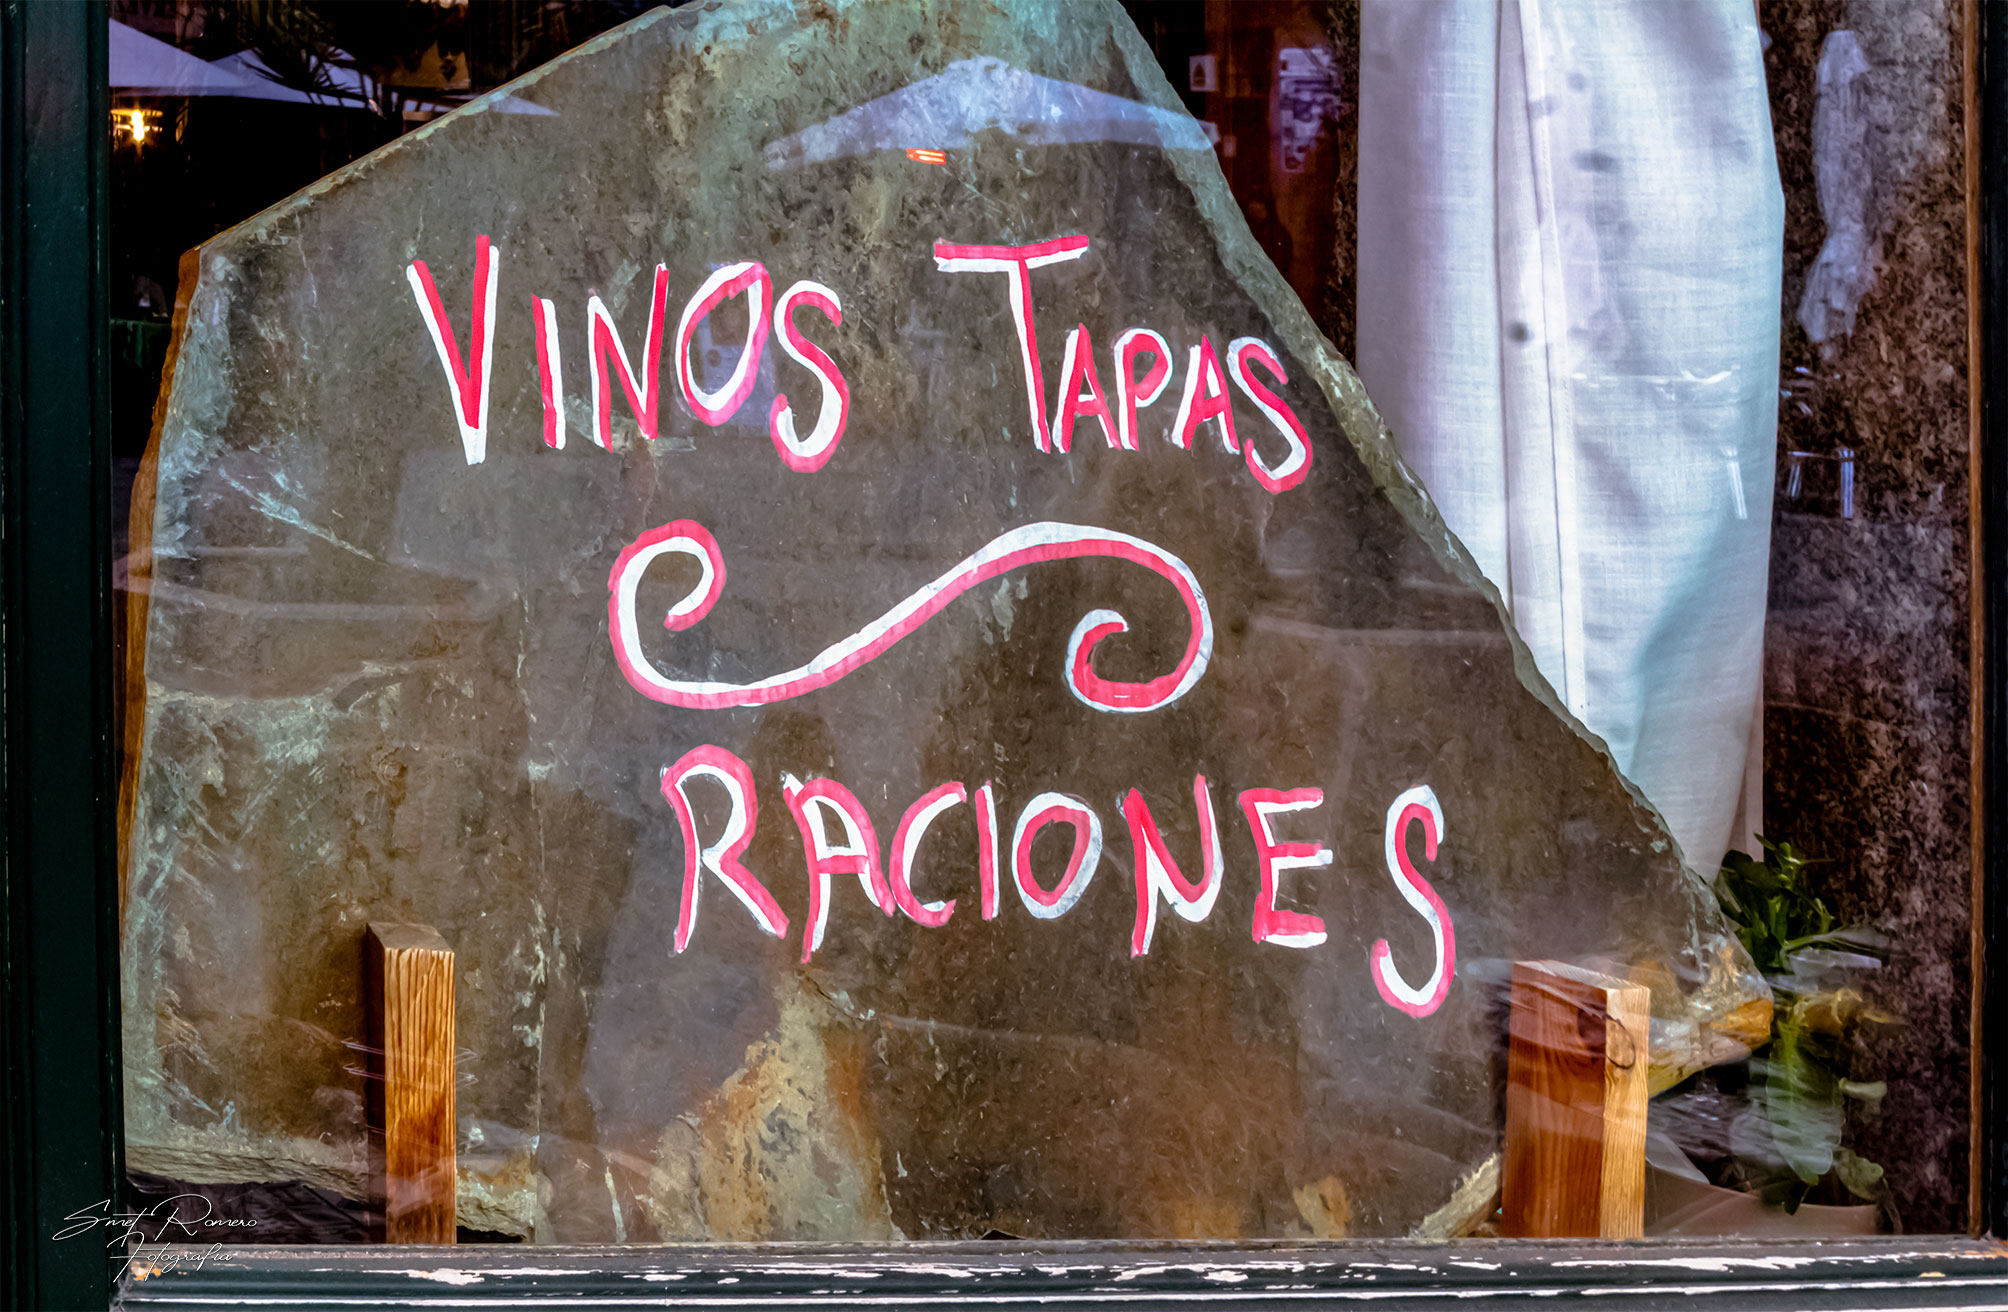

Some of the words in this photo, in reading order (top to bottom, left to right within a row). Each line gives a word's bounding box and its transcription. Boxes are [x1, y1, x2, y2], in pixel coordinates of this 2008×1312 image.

[407, 234, 849, 473] VINOS
[934, 234, 1313, 494] TAPAS
[660, 743, 1456, 1018] RACIONES
